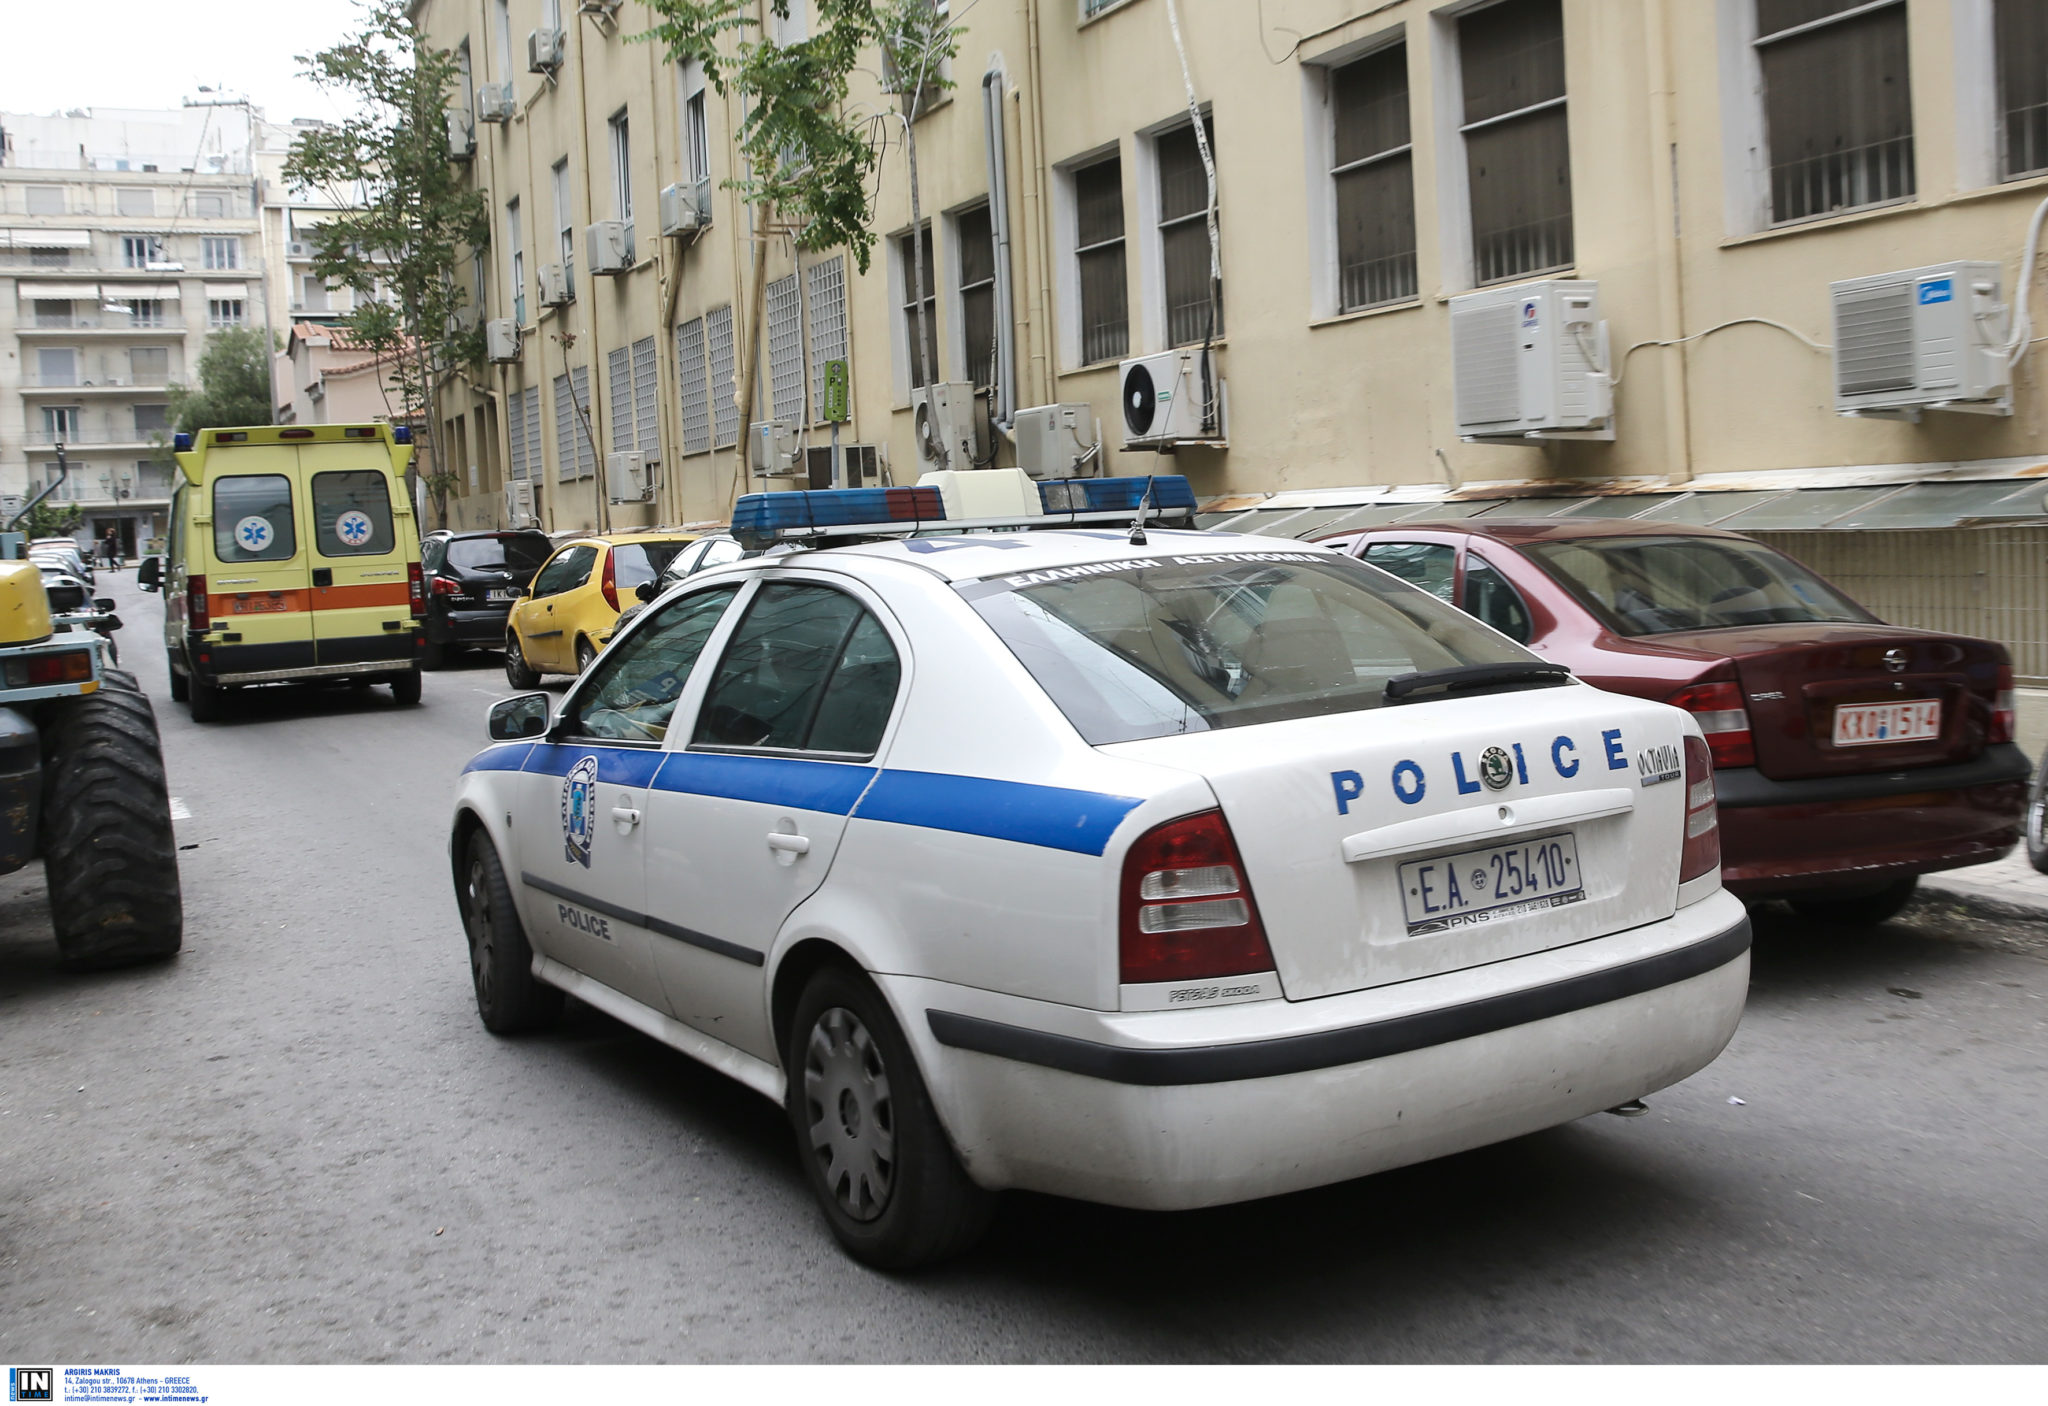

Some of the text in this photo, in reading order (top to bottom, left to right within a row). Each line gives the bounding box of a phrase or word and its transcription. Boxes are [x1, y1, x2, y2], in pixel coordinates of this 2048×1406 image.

[1003, 552, 1331, 588] ΕΛΛΗΝΙΚΗ ΑΣΤΥΝΟΜΙΑ
[1330, 728, 1629, 816] POLICE
[1490, 843, 1566, 900] 25410
[558, 903, 612, 941] POLICE
[1450, 911, 1490, 928] PNS
